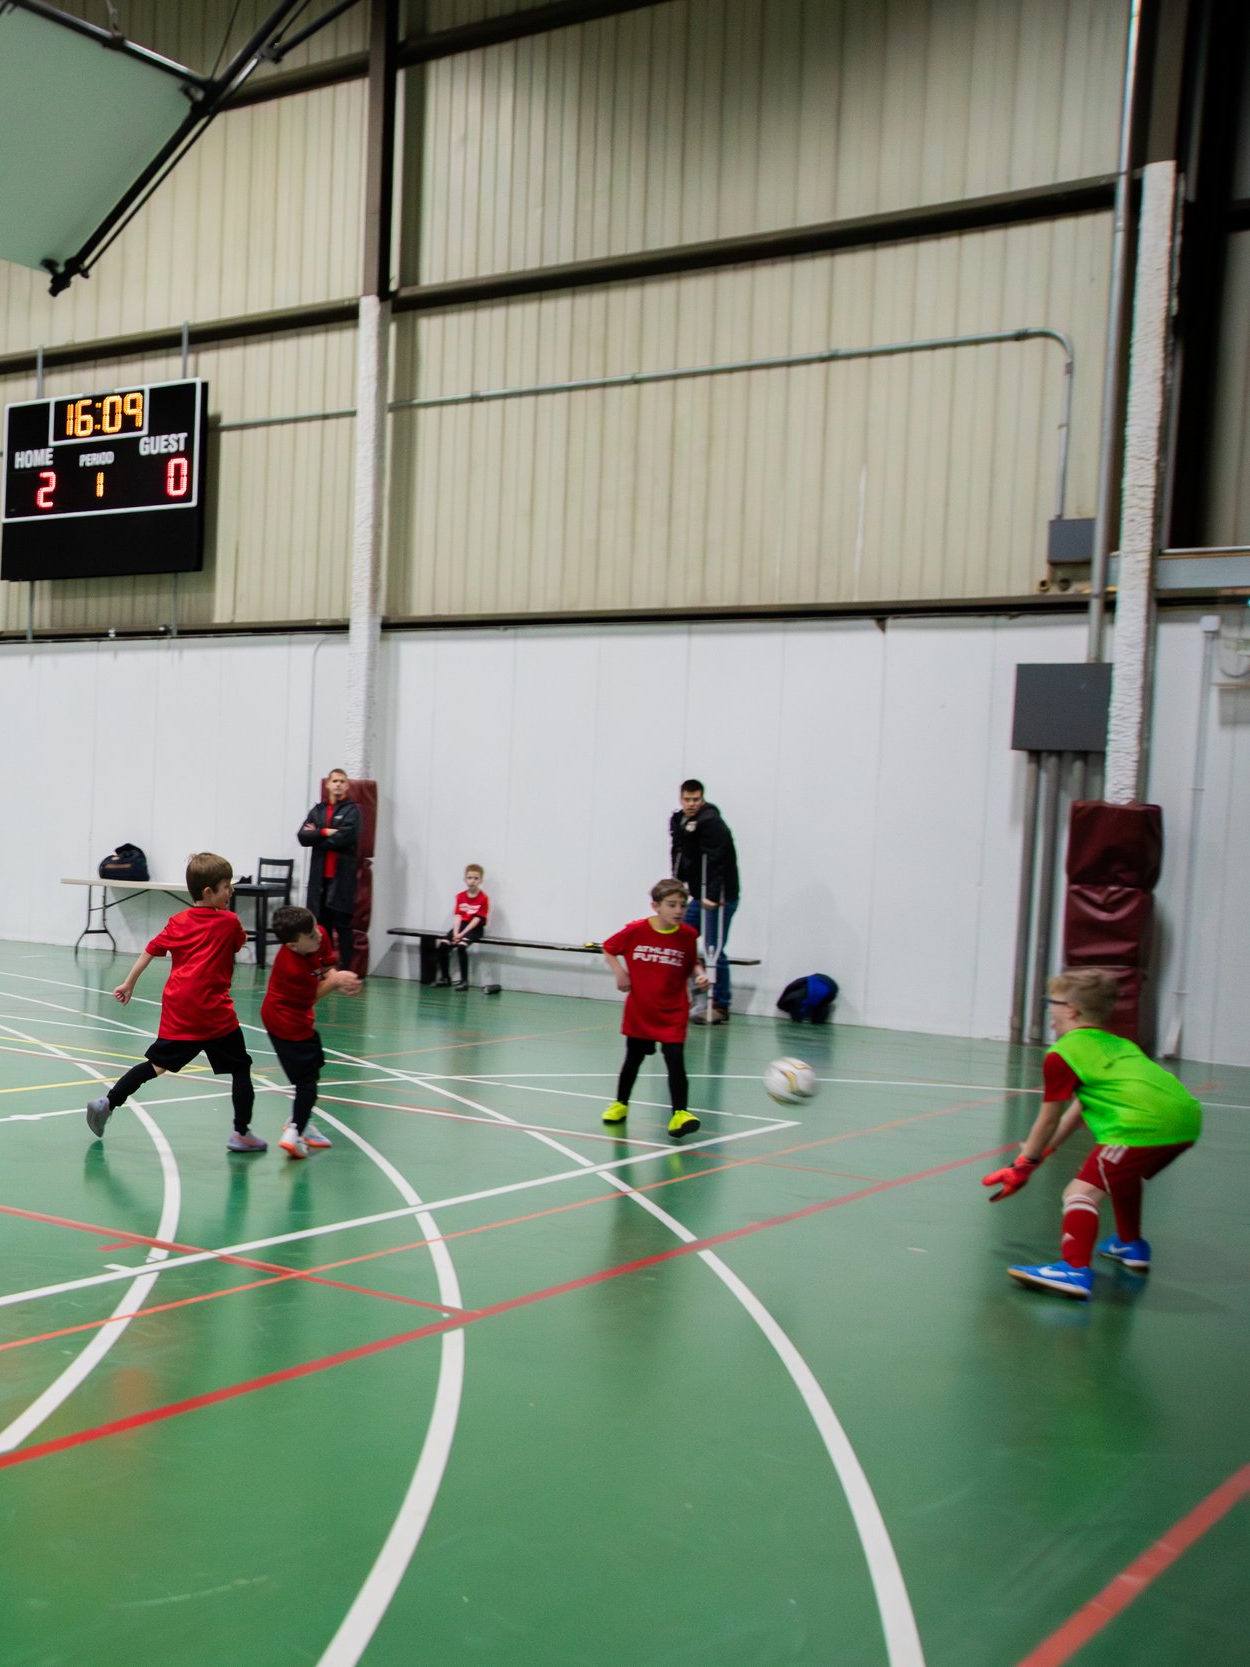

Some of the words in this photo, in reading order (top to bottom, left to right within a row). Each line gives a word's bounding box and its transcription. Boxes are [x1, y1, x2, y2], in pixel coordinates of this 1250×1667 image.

[66, 392, 144, 437] 16:09
[139, 432, 188, 456] GUEST
[14, 448, 54, 469] HOME
[79, 451, 115, 468] PERIOD
[36, 471, 57, 508] 2
[96, 472, 105, 498] 1
[166, 457, 188, 497] 0
[633, 952, 683, 967] FUTSAL
